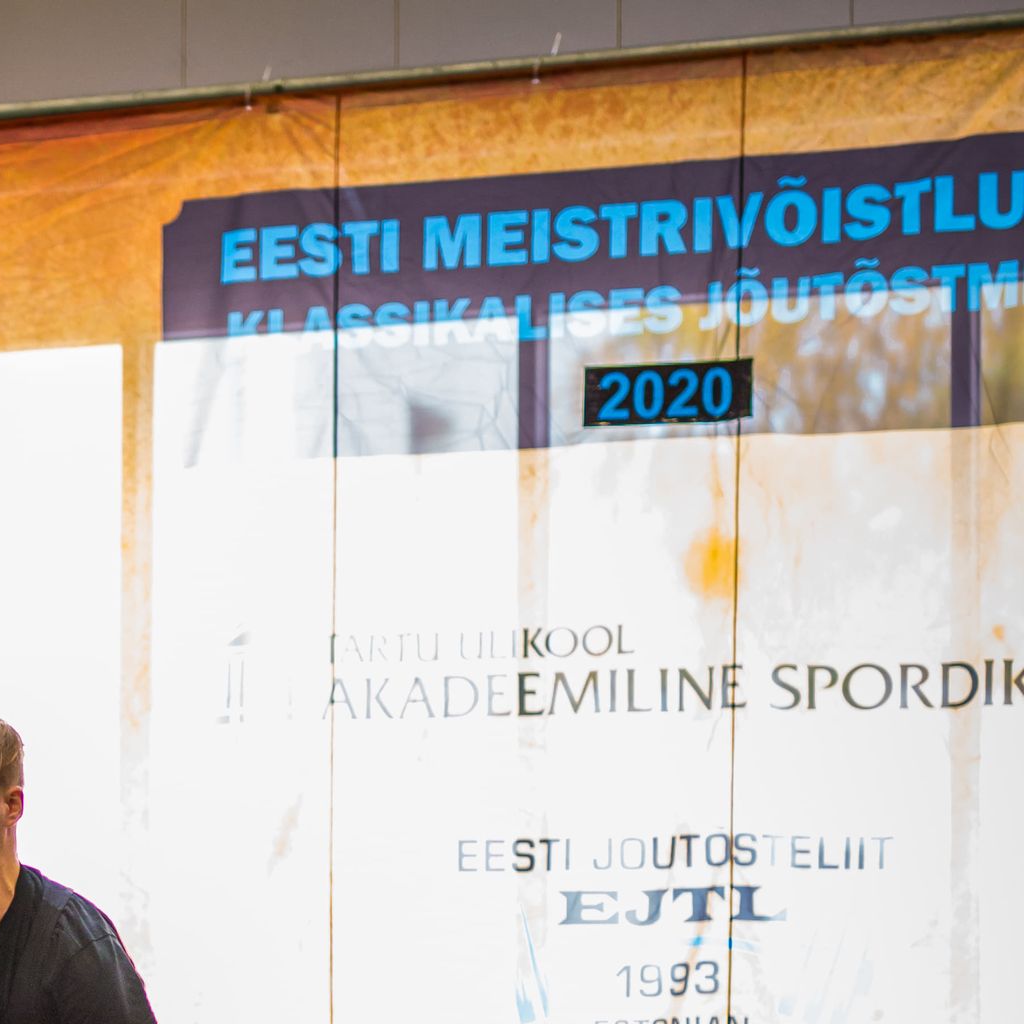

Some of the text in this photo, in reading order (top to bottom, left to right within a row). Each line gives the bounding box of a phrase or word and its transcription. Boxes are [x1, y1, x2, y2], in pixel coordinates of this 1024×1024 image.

[221, 169, 1024, 285] EESTI MEISTRIVÕISTLU
[226, 285, 684, 349] KLASSIKALISES
[597, 366, 734, 421] 2020
[323, 664, 747, 720] AKADEEMILINE
[458, 838, 571, 873] EESTI
[558, 885, 788, 927] EJTL
[616, 961, 720, 998] 1993
